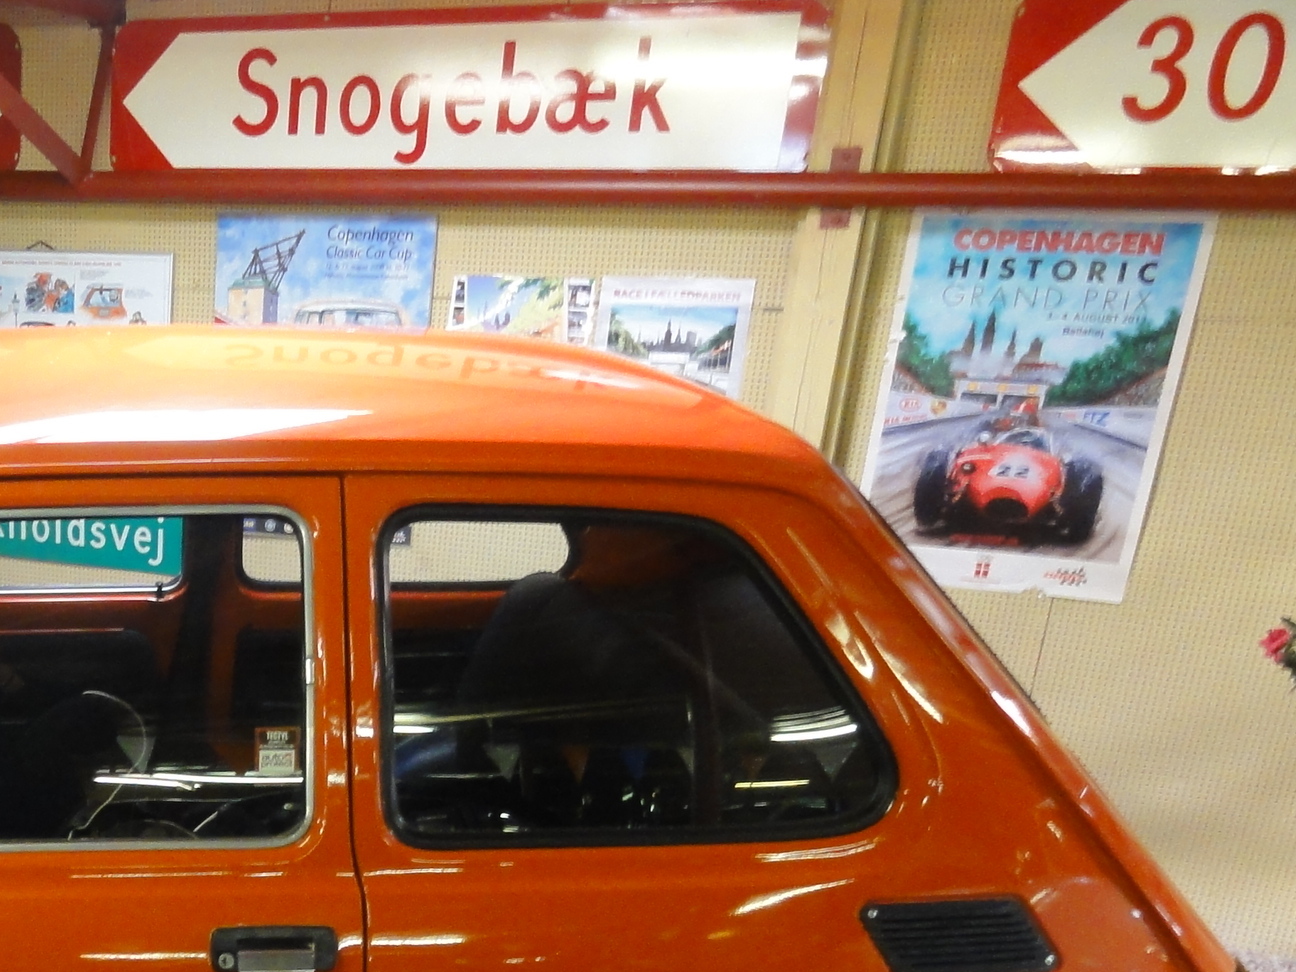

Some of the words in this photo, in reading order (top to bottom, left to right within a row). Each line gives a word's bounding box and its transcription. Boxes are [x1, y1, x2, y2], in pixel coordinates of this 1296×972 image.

[1122, 10, 1286, 123] 30
[232, 37, 670, 164] Snogebæk
[328, 224, 414, 246] Copenhagen
[955, 228, 1166, 256] COPENHAGEN
[326, 245, 362, 259] Classic
[366, 246, 386, 259] Car
[389, 245, 412, 262] Cup
[947, 257, 1158, 286] HISTORIC
[942, 284, 1064, 309] GRAND
[1083, 288, 1152, 312] PRIX
[997, 464, 1029, 479] 22
